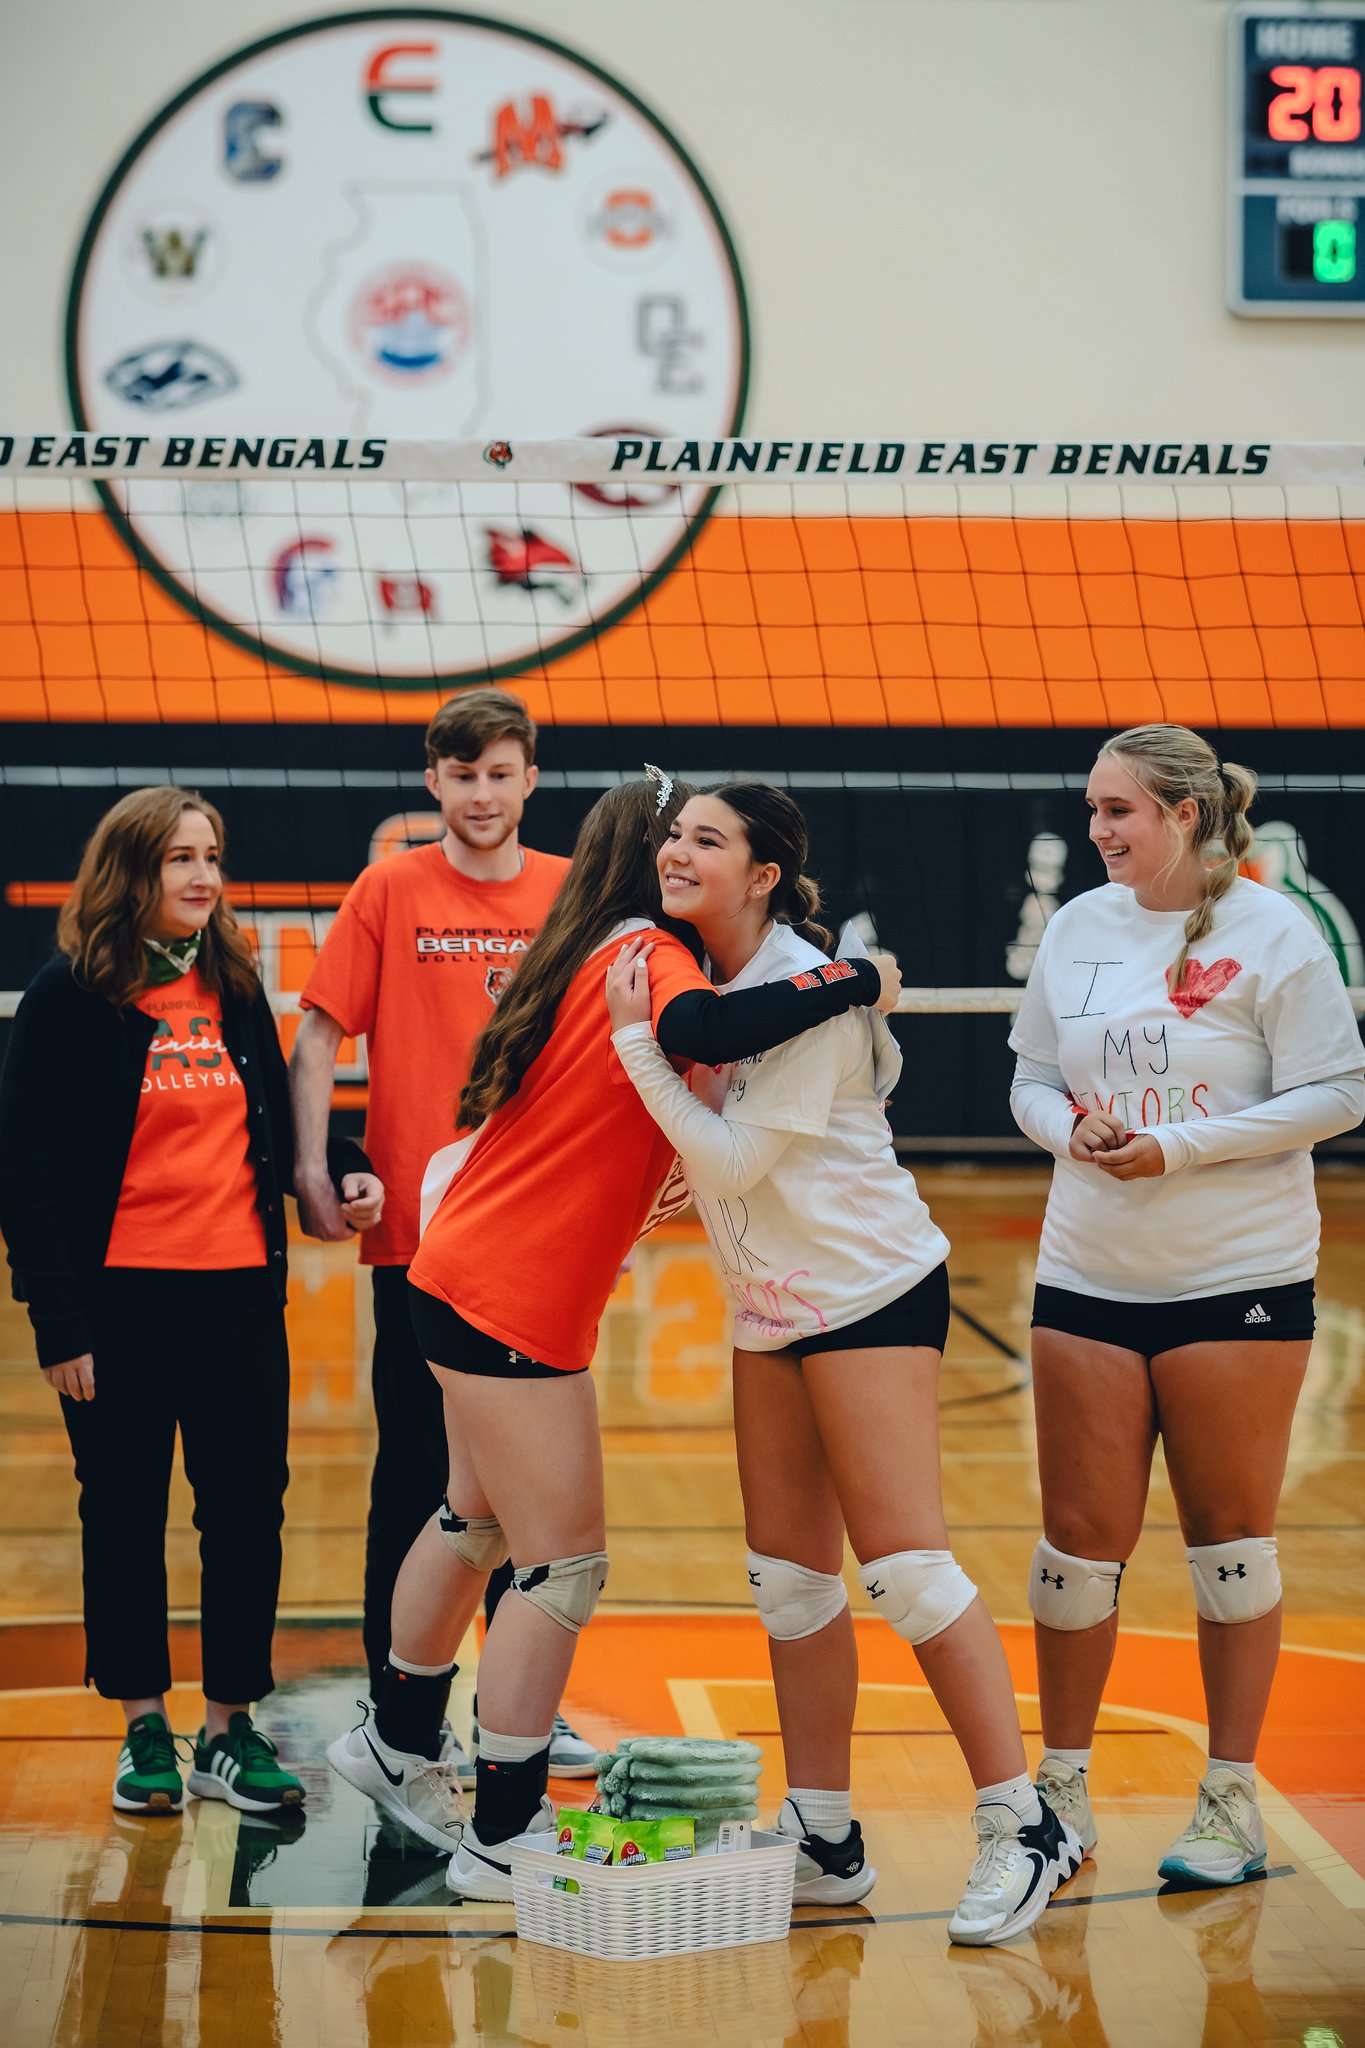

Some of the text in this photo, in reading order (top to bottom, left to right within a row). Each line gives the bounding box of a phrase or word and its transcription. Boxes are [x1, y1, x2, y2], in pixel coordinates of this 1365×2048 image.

[1268, 66, 1361, 142] 20
[1313, 220, 1355, 283] 0
[26, 437, 149, 467] EAST
[161, 438, 388, 469] BENGALS
[610, 441, 1270, 474] PLAINFIELD EAST BENGALS
[415, 927, 522, 937] PLAINFIELD
[416, 937, 530, 954] BENGA
[788, 959, 858, 991] WE ARE
[1104, 1024, 1169, 1079] MY
[141, 1072, 241, 1093] OLLEYBA
[1244, 1315, 1271, 1324] adidas
